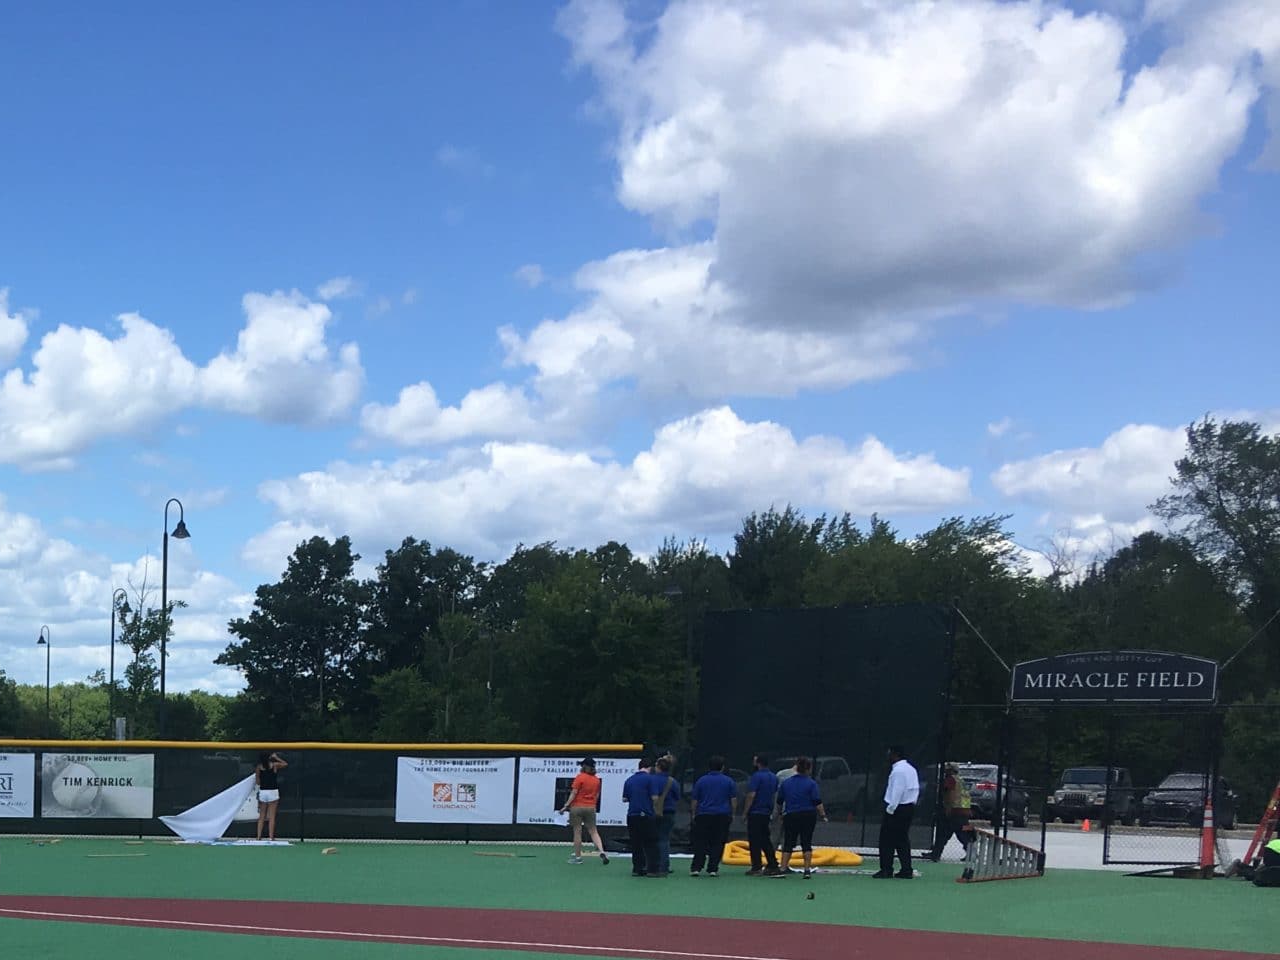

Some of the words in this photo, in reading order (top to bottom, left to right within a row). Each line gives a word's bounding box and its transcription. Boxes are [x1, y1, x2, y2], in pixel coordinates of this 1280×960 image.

[1024, 672, 1129, 688] MIRACLE
[1136, 671, 1204, 688] FIELD
[62, 777, 82, 787] TIM
[86, 777, 134, 787] KENRICK
